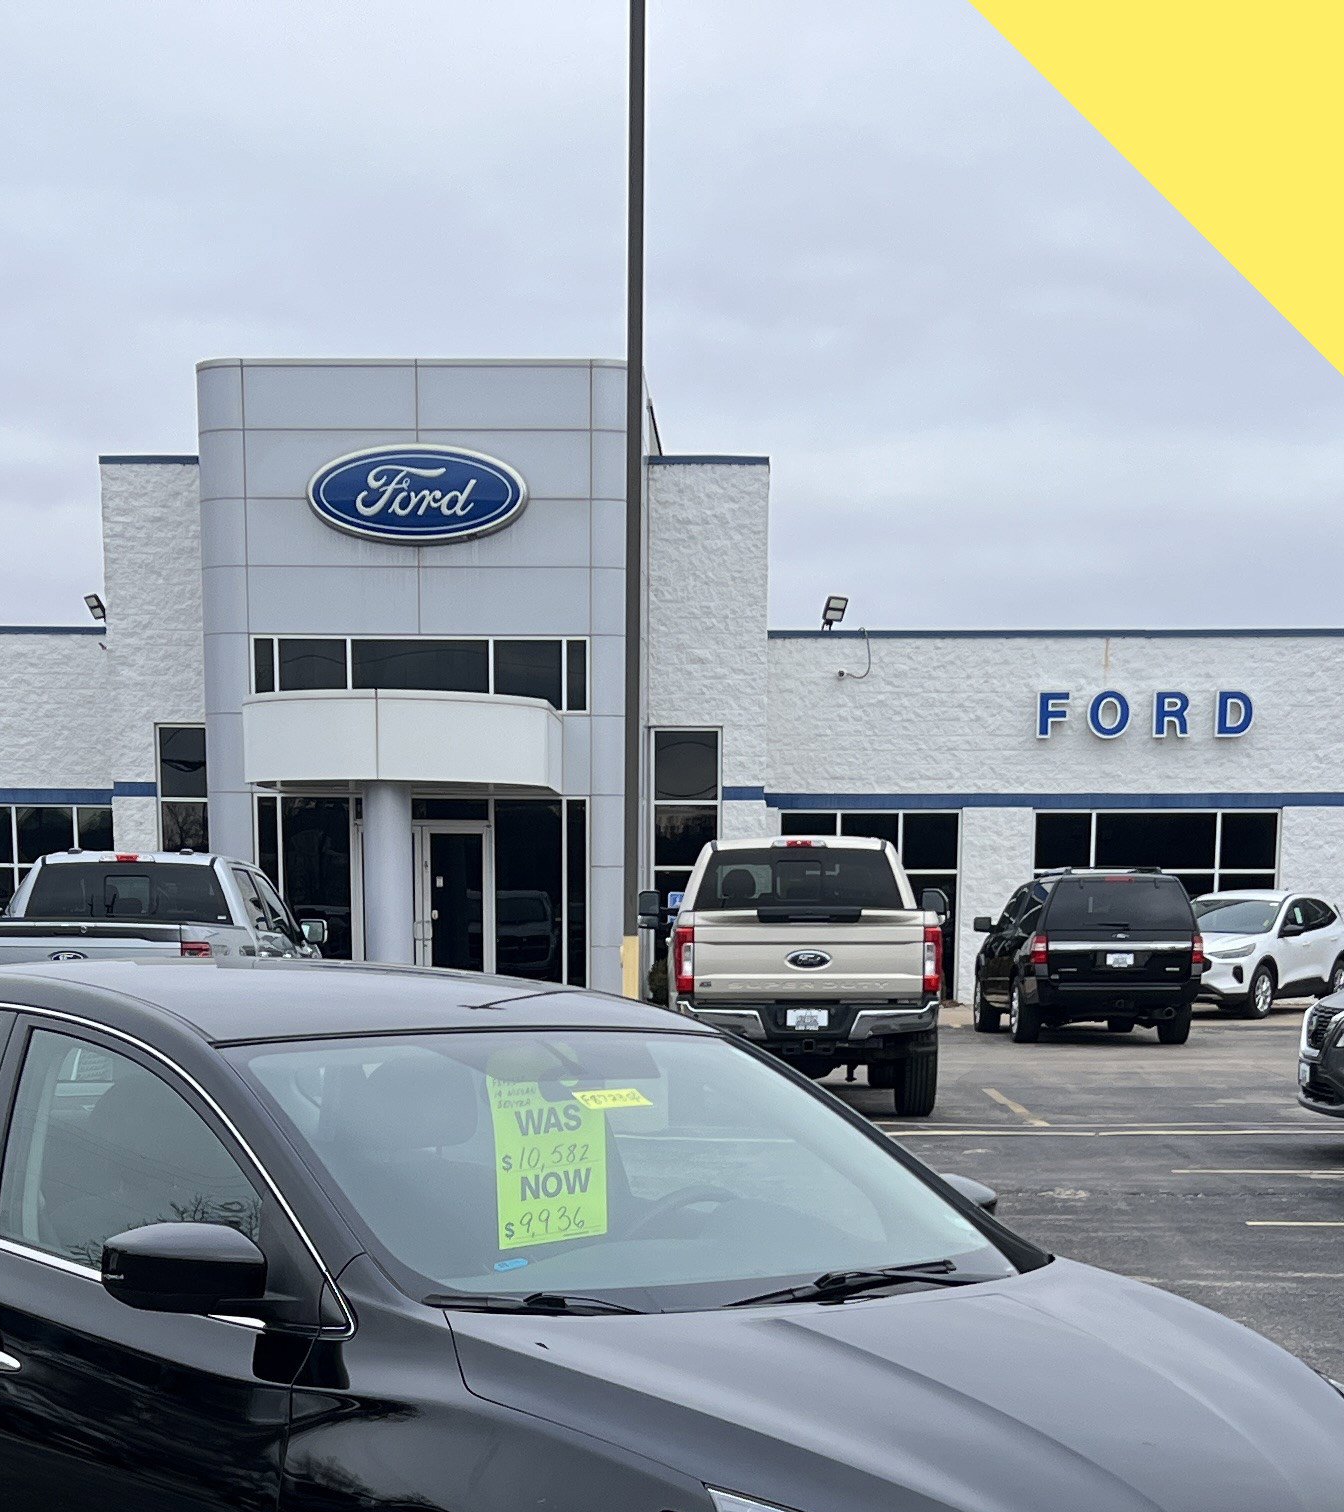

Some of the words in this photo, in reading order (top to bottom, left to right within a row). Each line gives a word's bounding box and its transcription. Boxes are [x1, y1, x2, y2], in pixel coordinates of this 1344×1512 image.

[355, 463, 478, 519] Ford
[1037, 690, 1254, 740] FORD
[515, 1104, 582, 1136] WAS
[520, 1168, 592, 1202] NOW
